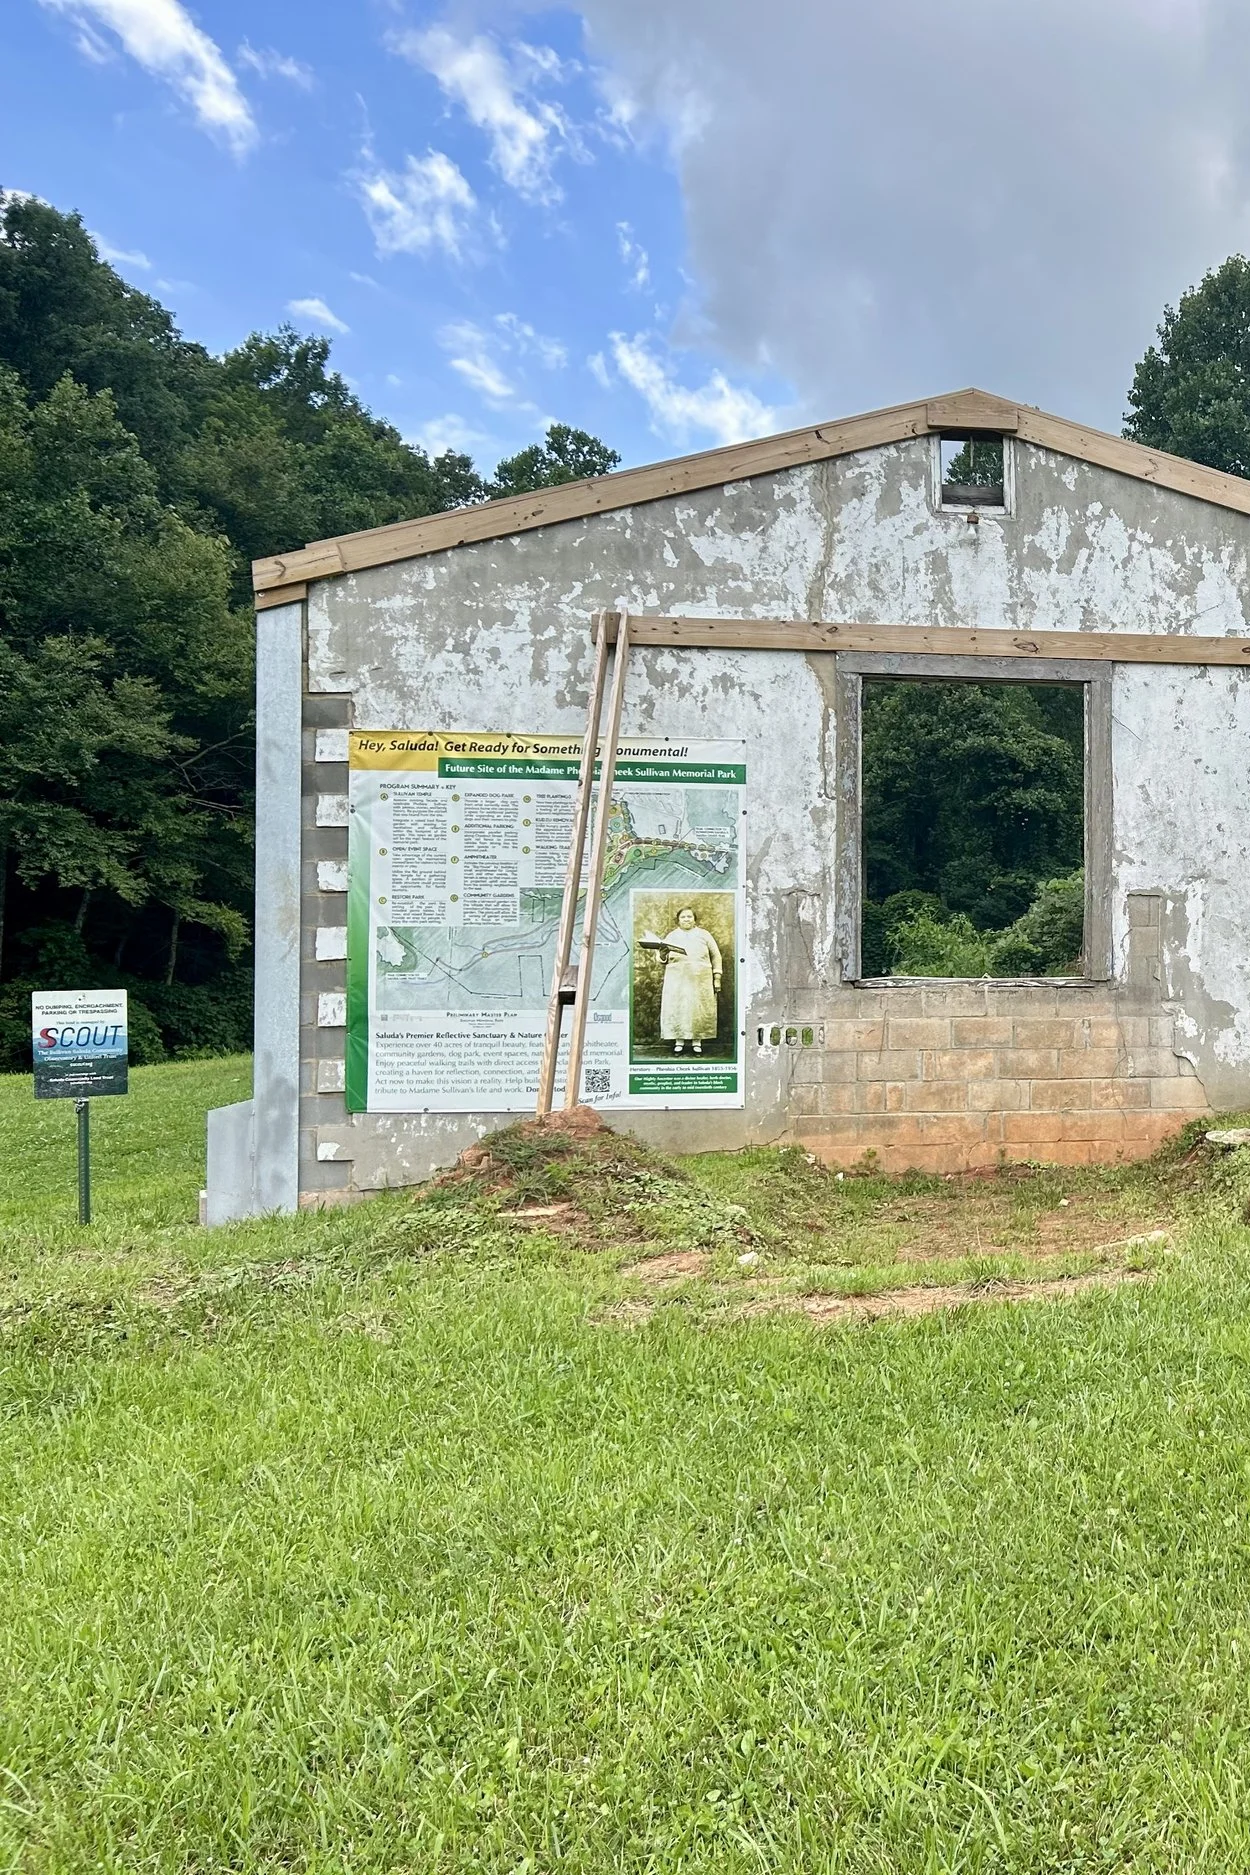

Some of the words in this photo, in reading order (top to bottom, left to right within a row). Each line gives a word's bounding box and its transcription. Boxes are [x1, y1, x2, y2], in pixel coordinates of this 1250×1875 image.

[358, 740, 386, 753] Hey,
[389, 740, 439, 751] Saluda!
[444, 741, 466, 752] Get
[469, 742, 507, 755] Ready
[511, 742, 530, 755] for
[533, 743, 601, 757] Somethig
[616, 746, 689, 757] onumental!
[445, 763, 475, 773] Future
[477, 764, 495, 773] Site
[497, 764, 507, 773] of
[508, 764, 523, 774] the
[525, 764, 565, 775] Madame
[614, 767, 634, 776] heek
[635, 768, 670, 777] Sullivan
[672, 769, 715, 778] Memorial
[717, 770, 737, 779] Park
[37, 1025, 123, 1048] SCOUT
[436, 1031, 471, 1039] Reflective
[472, 1032, 507, 1040] Sanctuary
[375, 1041, 415, 1049] Experience
[473, 1041, 500, 1049] tranquil
[375, 1051, 415, 1059] community
[448, 1050, 462, 1058] dog
[375, 1060, 395, 1068] Enjoy
[396, 1059, 427, 1068] peaceful
[429, 1059, 456, 1068] walking
[375, 1069, 403, 1077] creating
[505, 1077, 522, 1085] Help
[441, 1086, 474, 1094] Sullivan's
[593, 1094, 604, 1104] for
